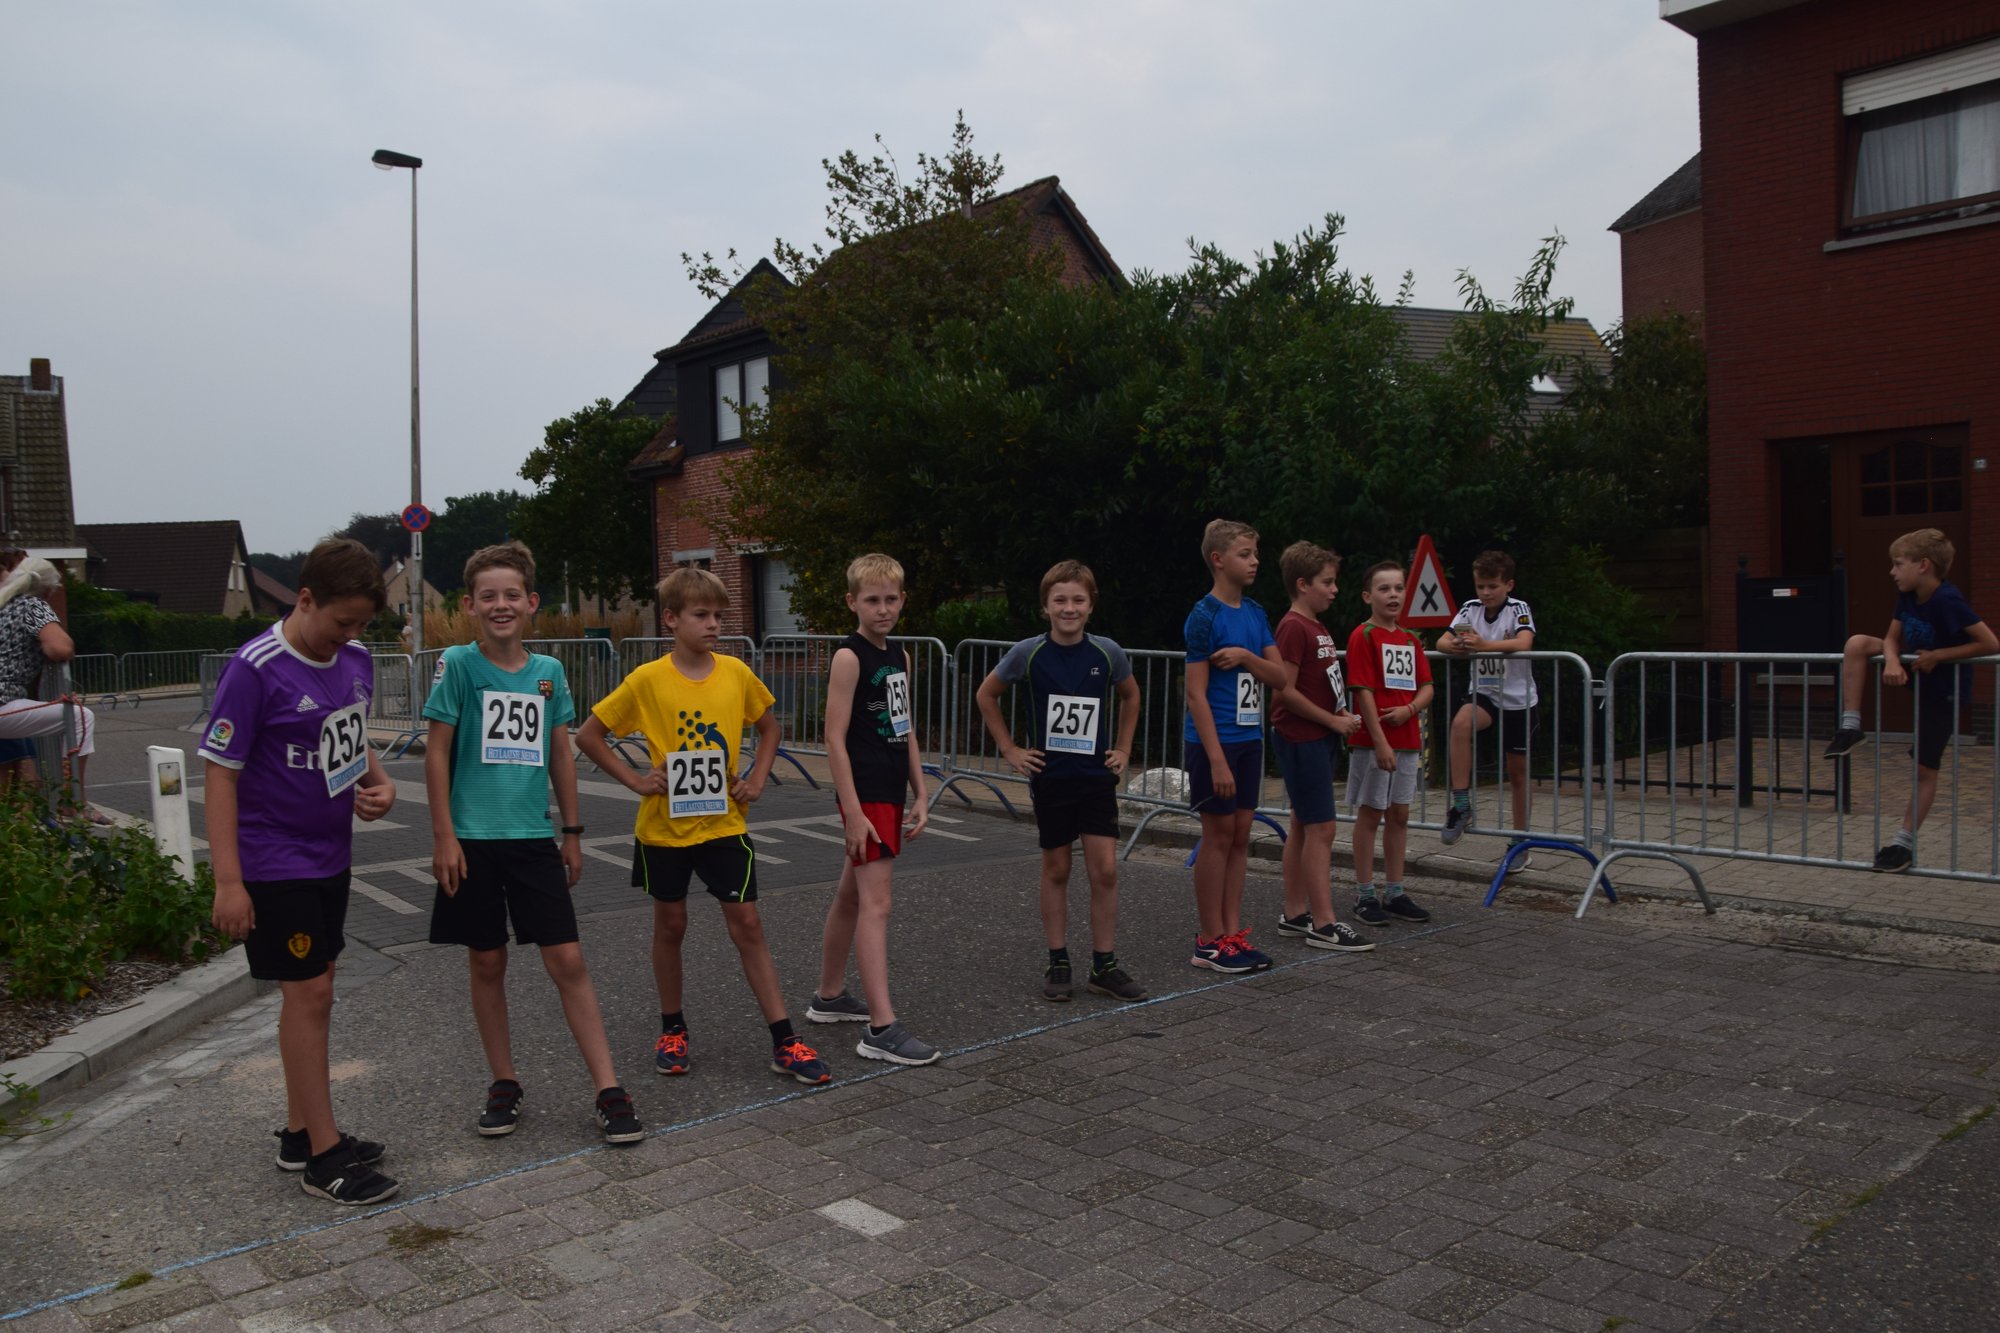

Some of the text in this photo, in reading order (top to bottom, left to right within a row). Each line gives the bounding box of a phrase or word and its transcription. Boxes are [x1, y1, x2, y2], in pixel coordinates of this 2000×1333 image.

[1385, 649, 1413, 676] 253
[1240, 678, 1261, 708] 25
[487, 699, 539, 742] 259
[1050, 701, 1095, 736] 257
[322, 712, 365, 772] 252
[672, 757, 723, 796] 255
